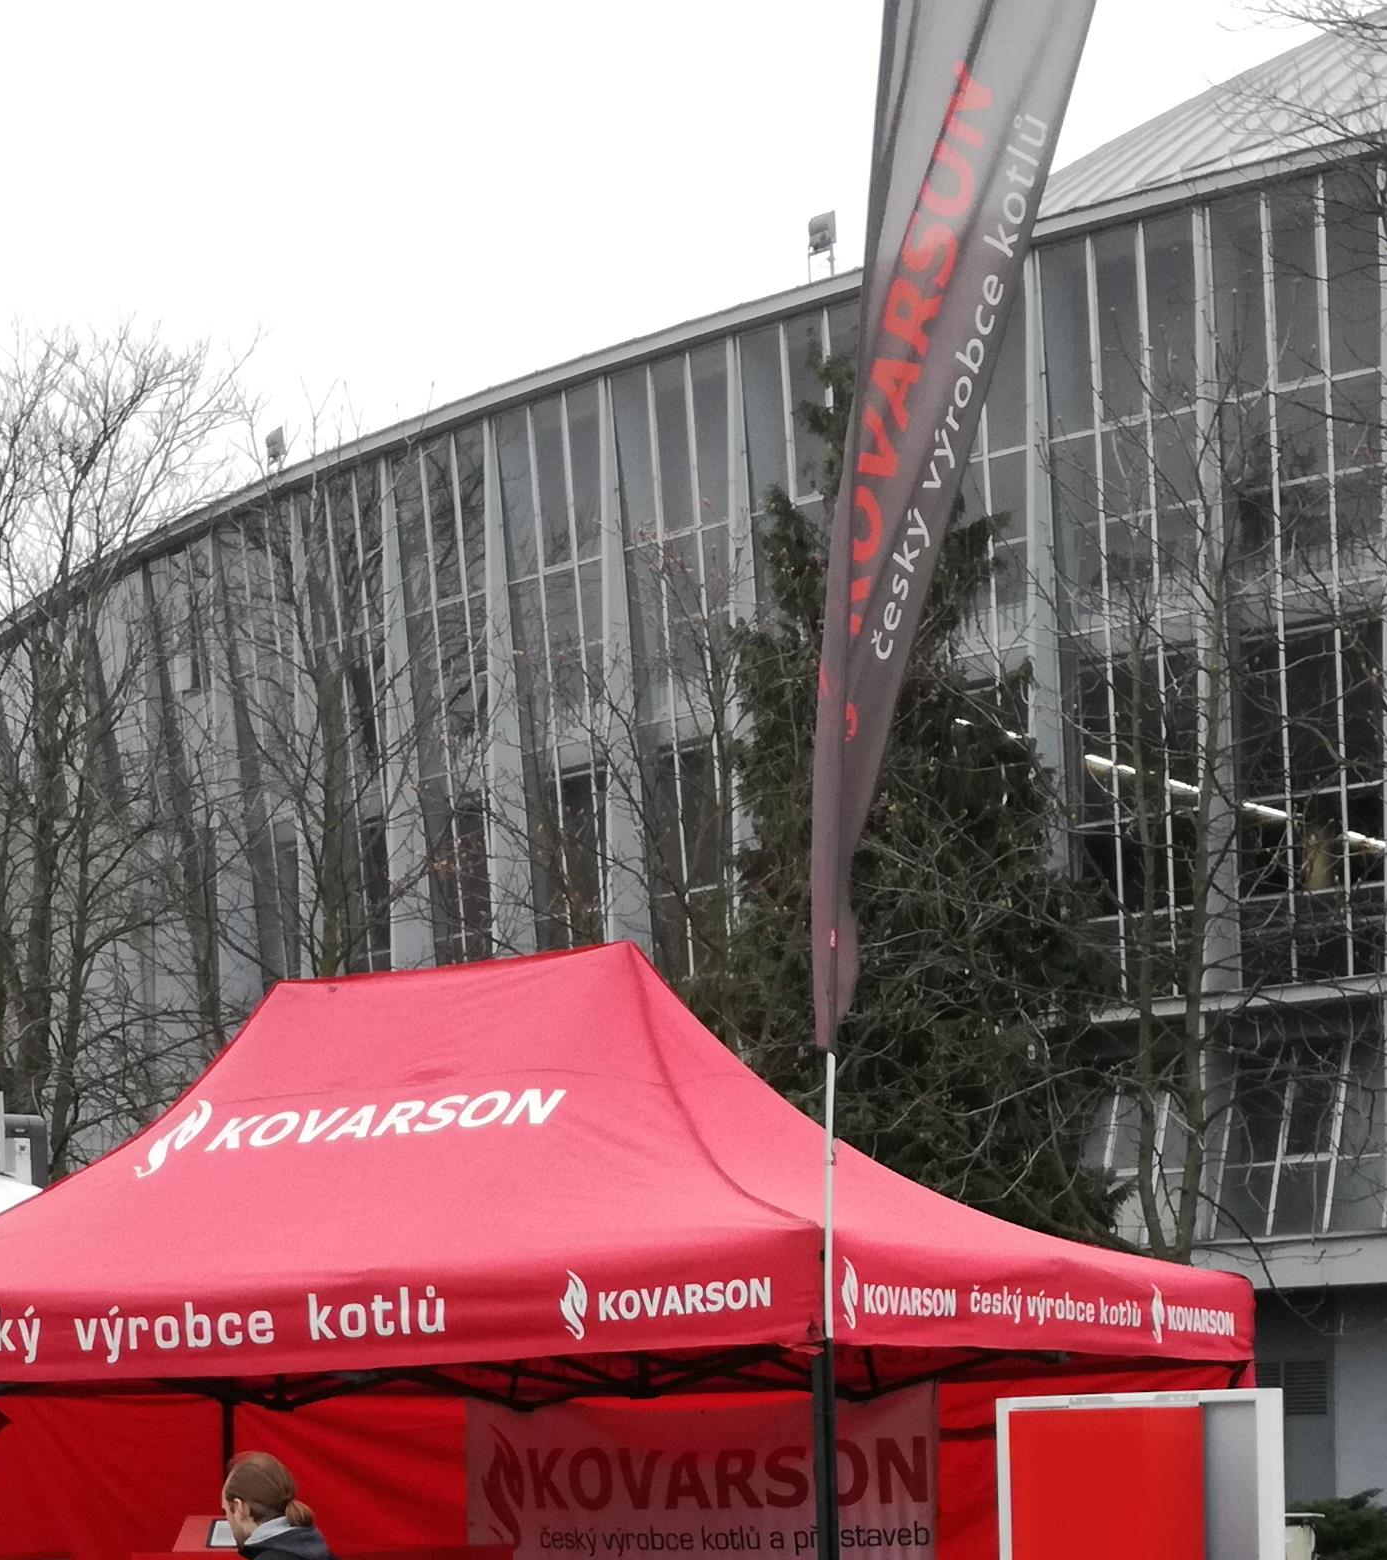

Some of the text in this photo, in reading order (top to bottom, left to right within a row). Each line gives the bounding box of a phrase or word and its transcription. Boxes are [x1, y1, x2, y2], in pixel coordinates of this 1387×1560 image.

[870, 111, 1049, 662] český výrobce kotlů
[205, 1088, 566, 1153] KOVARSON
[74, 1301, 276, 1364] výrobce
[307, 1284, 447, 1342] kotlů
[598, 1276, 772, 1323] KOVARSON
[863, 1283, 1236, 1338] KOVARSON český výrobce kotlů KOVARSON
[526, 1435, 930, 1513] KOVARSON
[539, 1520, 930, 1557] český výrobce kotlů a přstaveb
